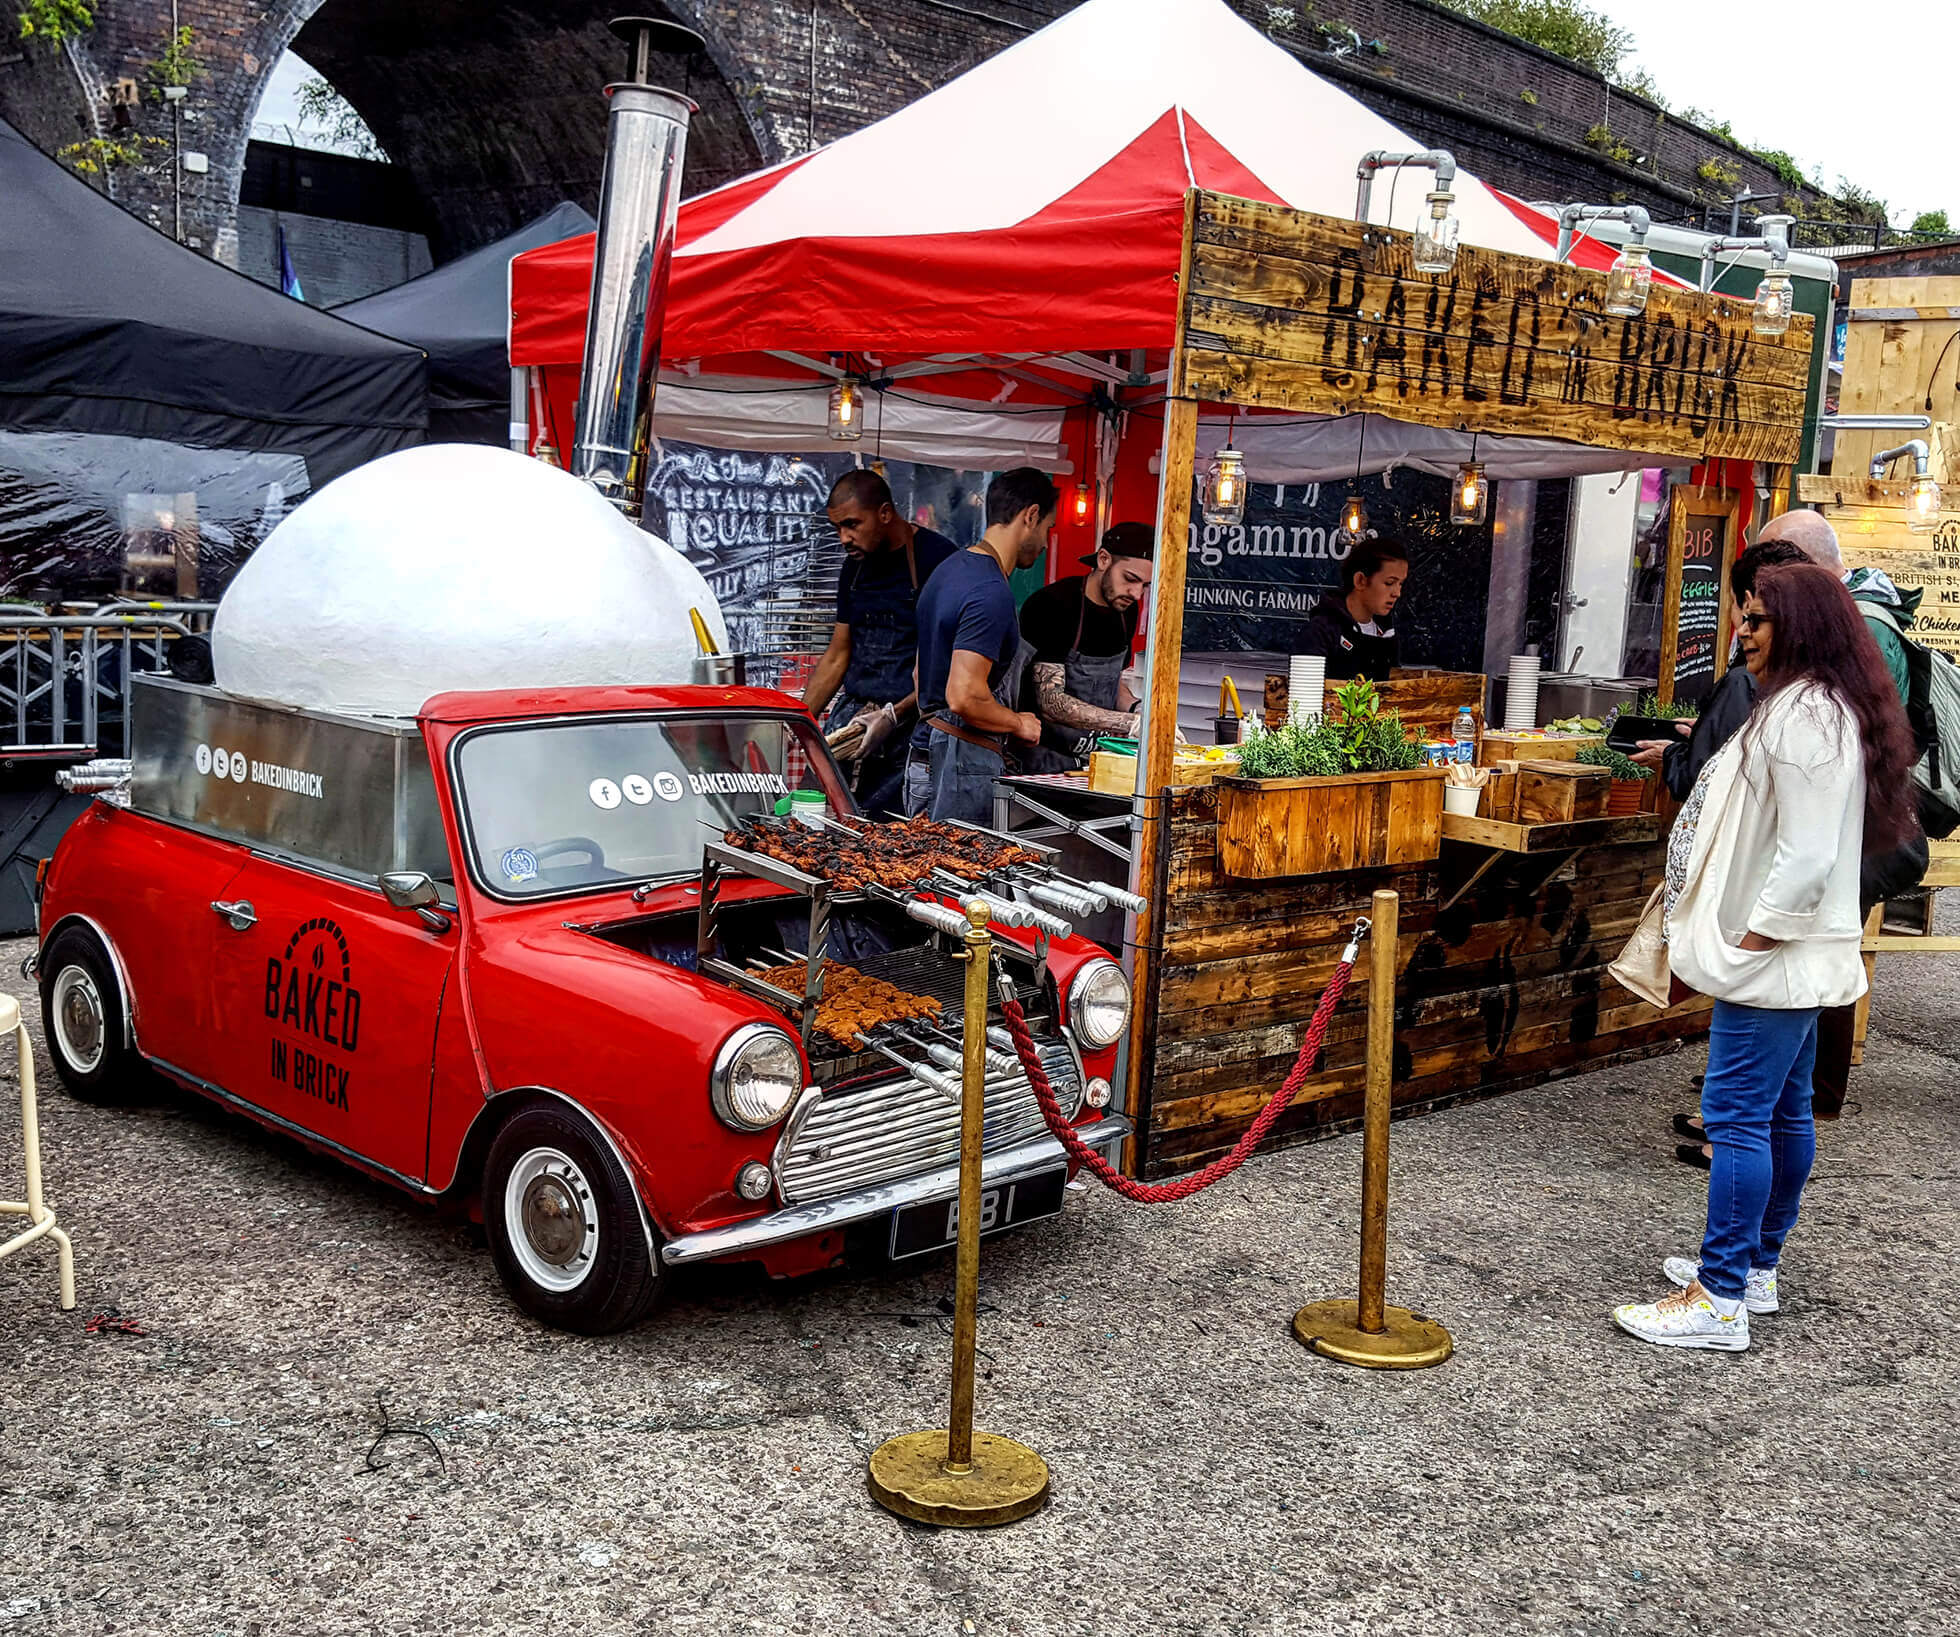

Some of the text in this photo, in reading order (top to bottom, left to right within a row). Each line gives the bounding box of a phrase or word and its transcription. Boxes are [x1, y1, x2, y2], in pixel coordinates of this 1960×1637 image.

[664, 486, 815, 513] RESTAURANT
[1683, 528, 1714, 560] BIB
[1937, 555, 1946, 569] IN
[1681, 580, 1714, 600] EGGIE
[1894, 573, 1942, 586] BRITISH
[1185, 586, 1254, 608] HINKING
[1921, 637, 1952, 646] FRESHLY
[251, 760, 324, 799] BAKEDINBRICK
[687, 772, 789, 795] BAKEDINBRICK
[264, 957, 361, 1053] BAKED
[271, 1037, 350, 1113] IN BRICK
